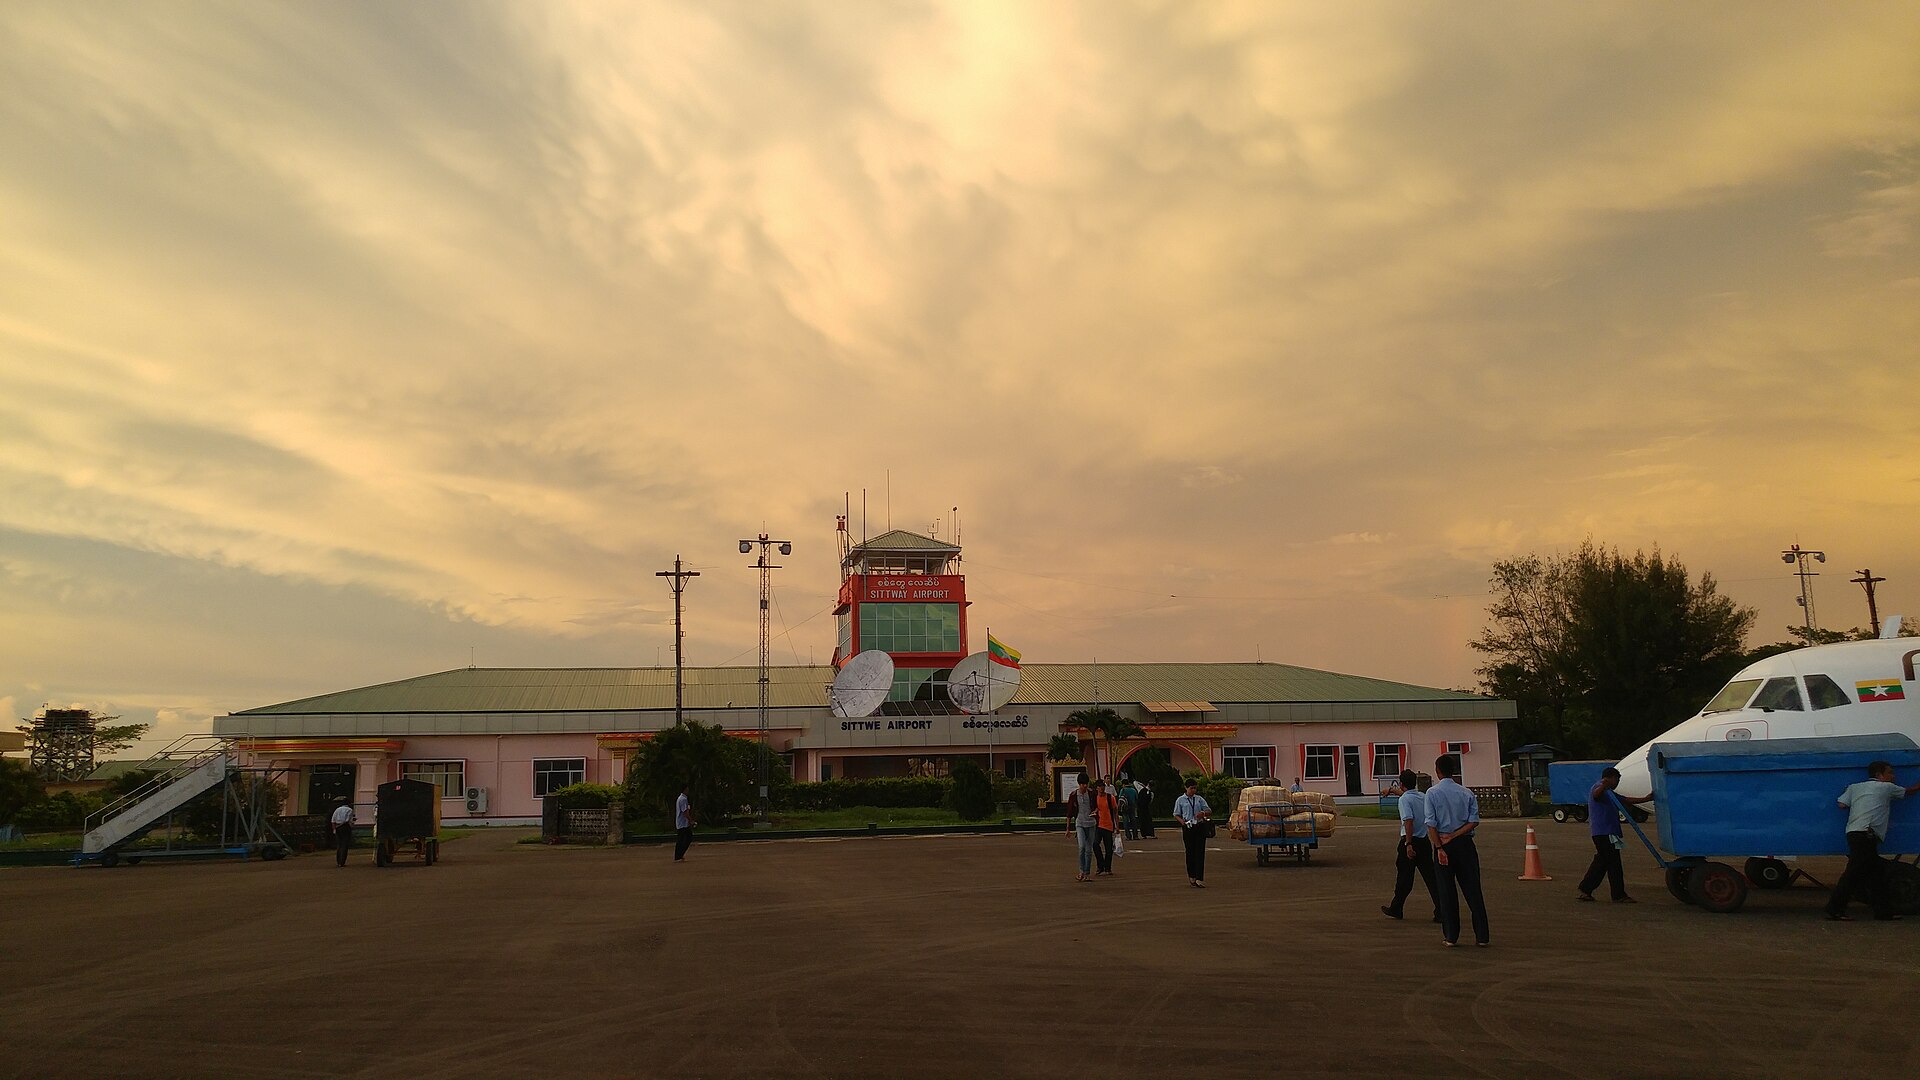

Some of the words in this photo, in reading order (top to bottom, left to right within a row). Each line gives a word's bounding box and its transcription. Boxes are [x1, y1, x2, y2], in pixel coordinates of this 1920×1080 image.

[870, 590, 908, 599] SITTWAY
[913, 590, 949, 599] AIRPORT
[841, 721, 880, 731] SITTWE
[887, 720, 933, 730] AIRPORT
